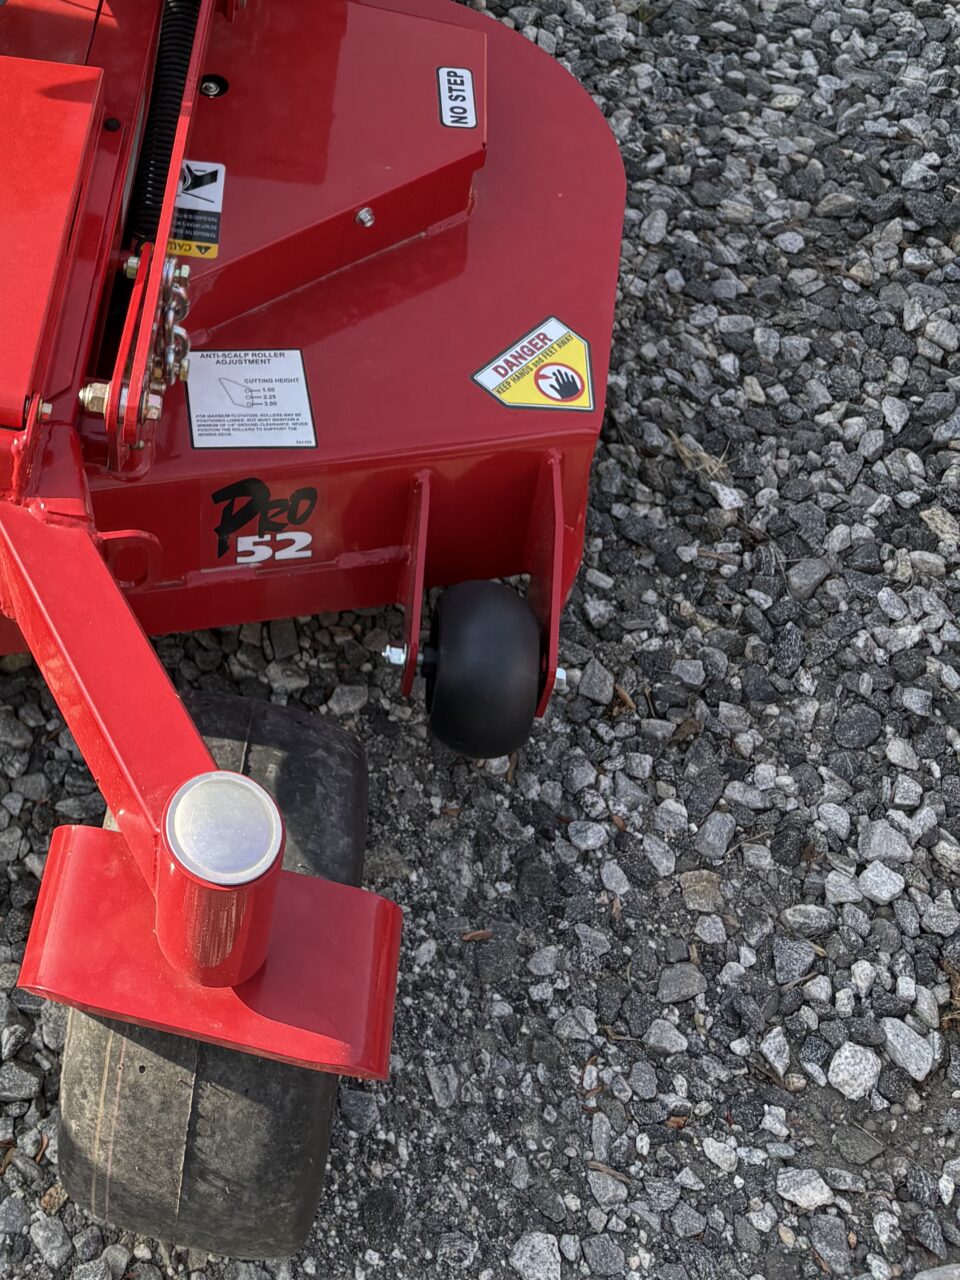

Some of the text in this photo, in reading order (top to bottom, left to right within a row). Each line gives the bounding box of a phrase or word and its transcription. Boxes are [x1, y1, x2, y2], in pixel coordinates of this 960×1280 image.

[447, 70, 469, 125] NO STEP
[492, 332, 554, 380] DANGER
[495, 381, 512, 395] KEEP
[511, 365, 534, 384] HANDS
[541, 346, 558, 360] FEET
[556, 334, 574, 349] AWAY
[236, 531, 312, 564] 52
